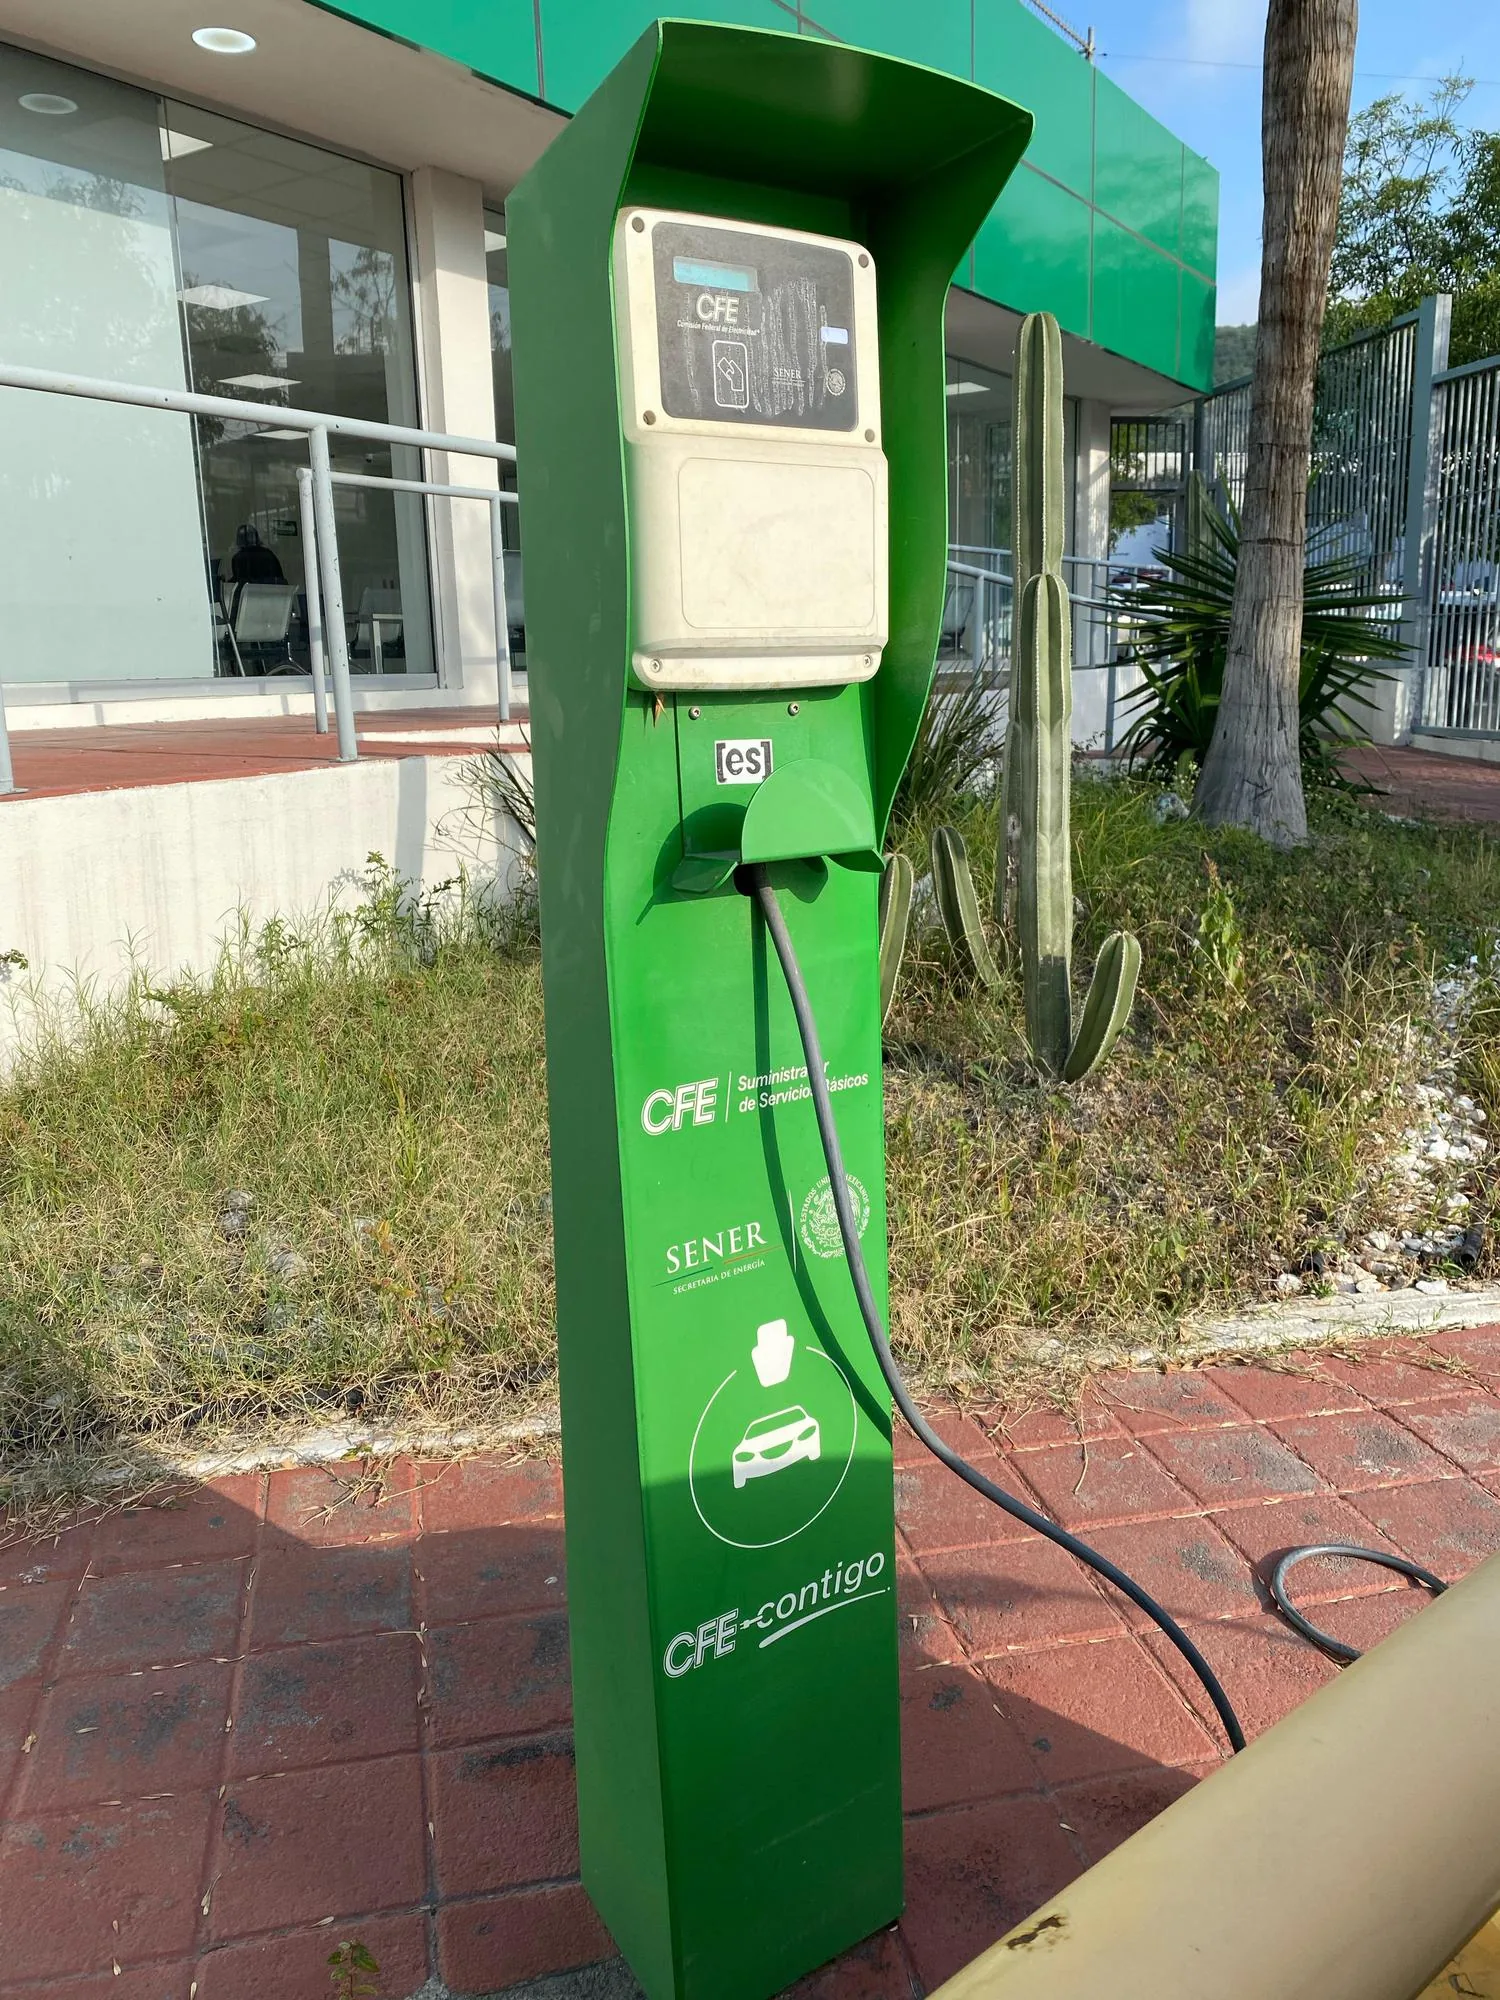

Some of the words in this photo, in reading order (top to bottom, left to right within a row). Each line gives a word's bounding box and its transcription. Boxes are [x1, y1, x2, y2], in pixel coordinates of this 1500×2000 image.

[696, 292, 740, 324] CFE
[773, 368, 802, 379] SENER
[738, 1061, 830, 1092] Suministrar
[641, 1078, 719, 1136] CFE
[739, 1096, 756, 1113] de
[666, 1221, 768, 1274] SENER
[720, 1270, 732, 1280] DE
[663, 1608, 739, 1679] CFE
[757, 1552, 885, 1629] contigo
